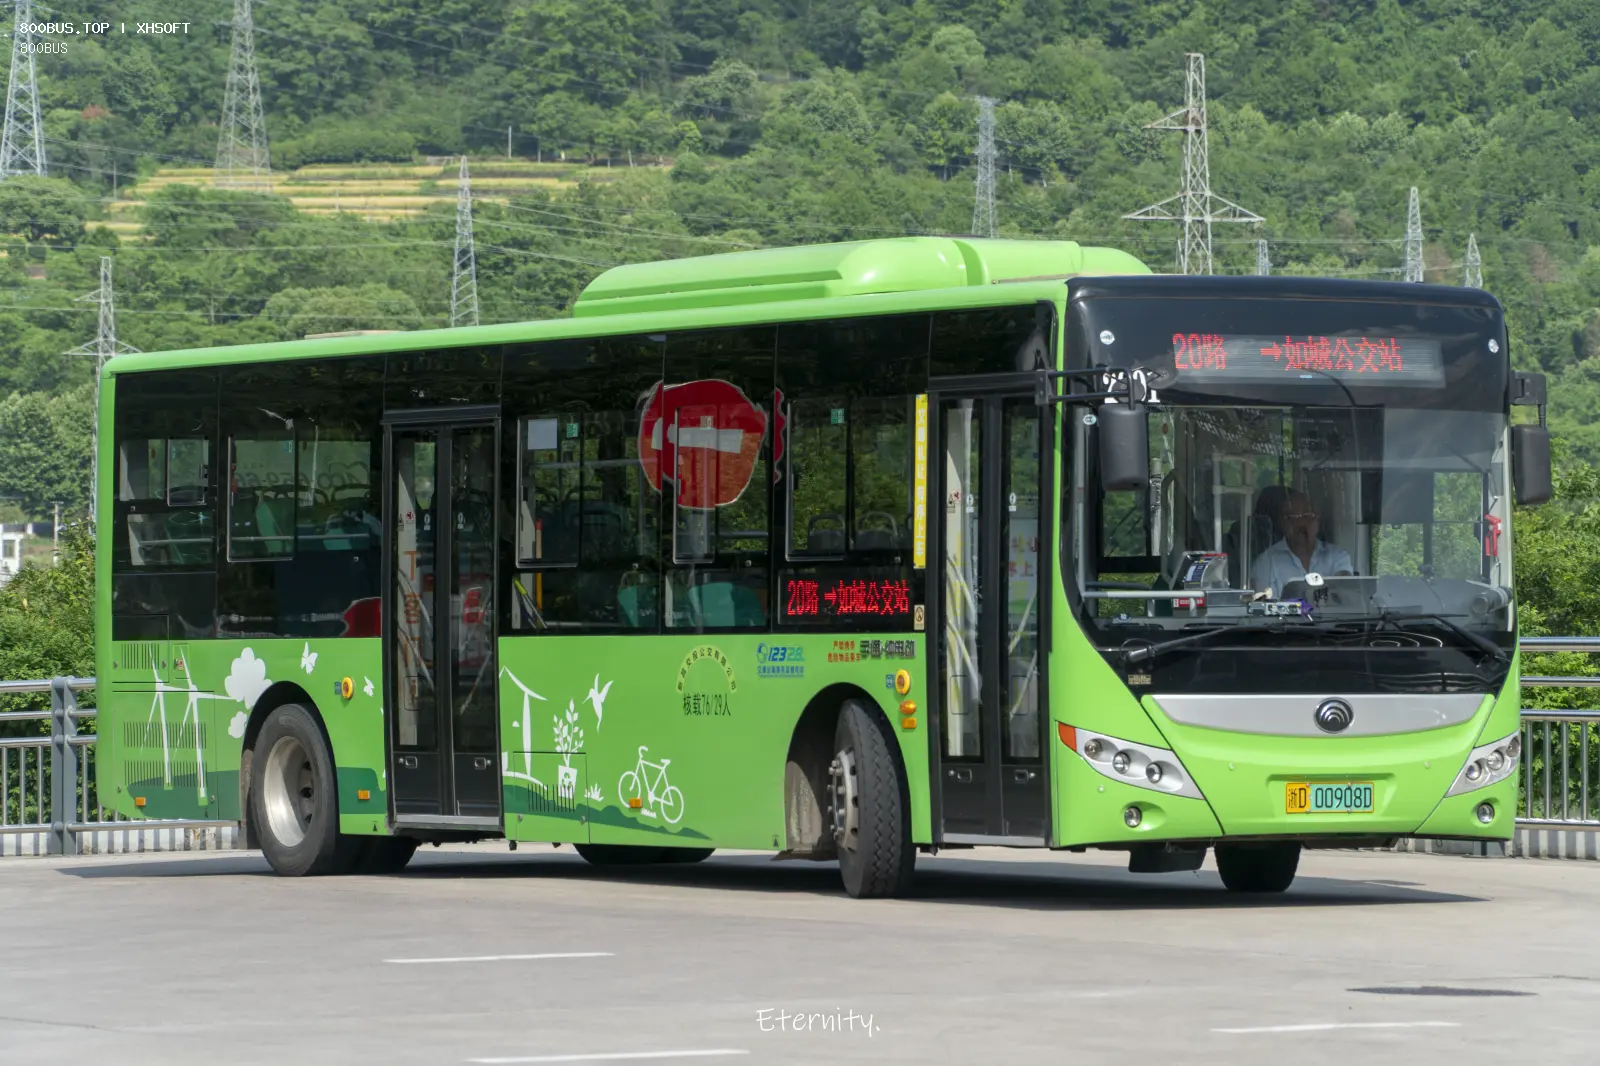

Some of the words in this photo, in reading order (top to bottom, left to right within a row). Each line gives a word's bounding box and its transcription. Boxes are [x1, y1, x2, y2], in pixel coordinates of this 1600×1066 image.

[1172, 333, 1228, 370] 20路
[1283, 335, 1403, 373] 如城公交站
[787, 579, 819, 615] 20路
[837, 579, 910, 615] 如城公交站
[1315, 787, 1372, 808] 00908D
